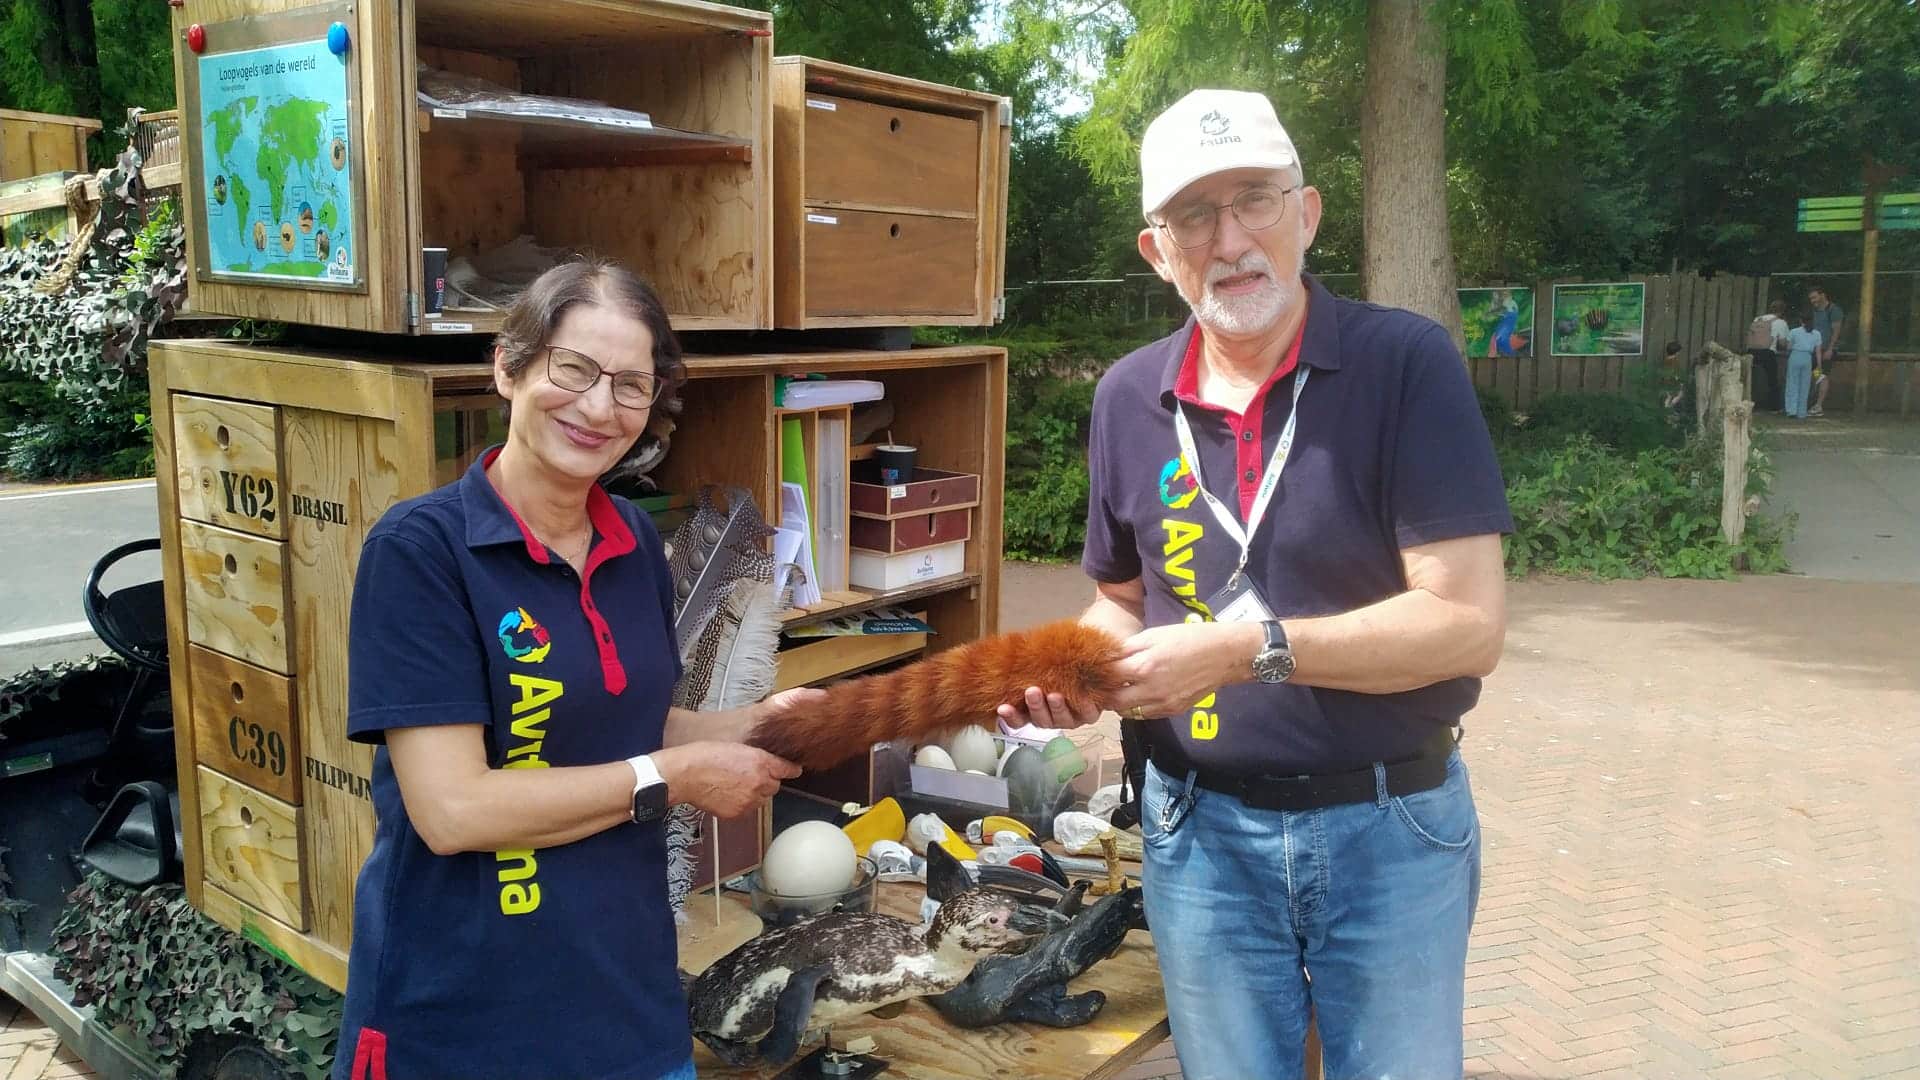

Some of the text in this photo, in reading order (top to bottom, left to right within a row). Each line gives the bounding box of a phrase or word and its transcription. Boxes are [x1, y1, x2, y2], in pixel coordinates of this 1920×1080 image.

[219, 54, 316, 82] Loopvogels van de wereld
[219, 470, 277, 522] Y62
[291, 493, 348, 526] BRASIL
[229, 715, 287, 777] C39
